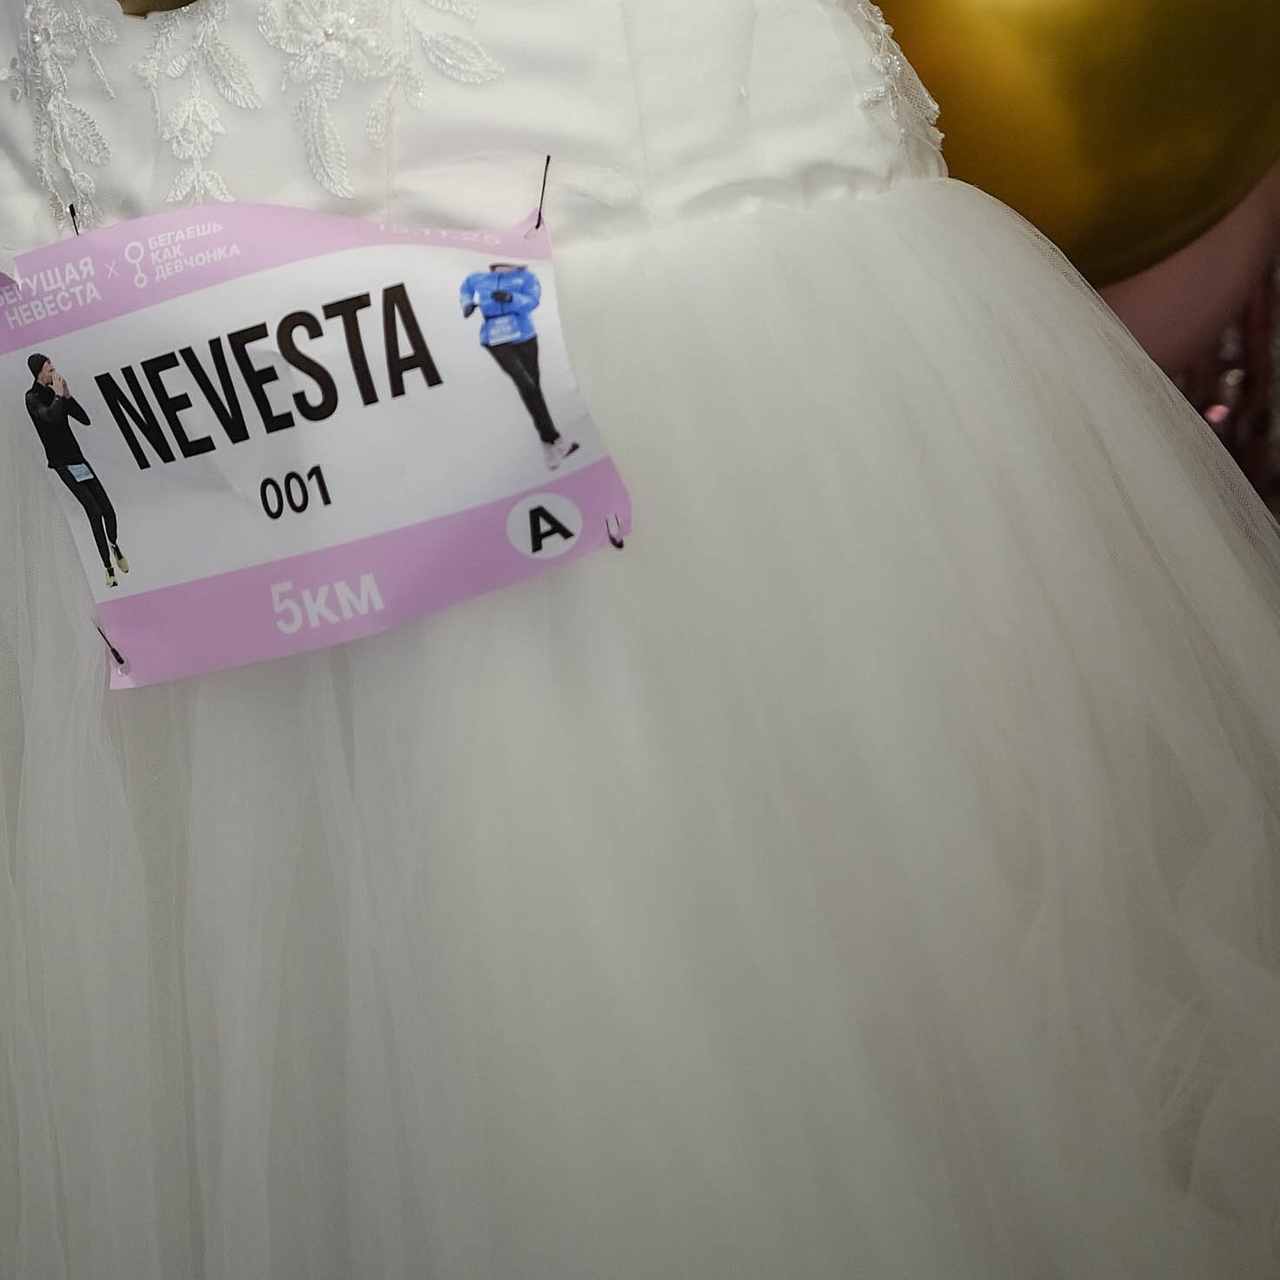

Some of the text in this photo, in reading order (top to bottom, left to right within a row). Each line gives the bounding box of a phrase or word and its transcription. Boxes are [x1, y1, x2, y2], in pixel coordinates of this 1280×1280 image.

[148, 221, 223, 251] БЕГАЕШЬ
[150, 242, 184, 265] КАК
[154, 243, 241, 283] ДЕВЧОНКА
[4, 281, 102, 330] НЕВЕСТА
[94, 282, 443, 470] NEVESTA
[260, 464, 332, 519] 001
